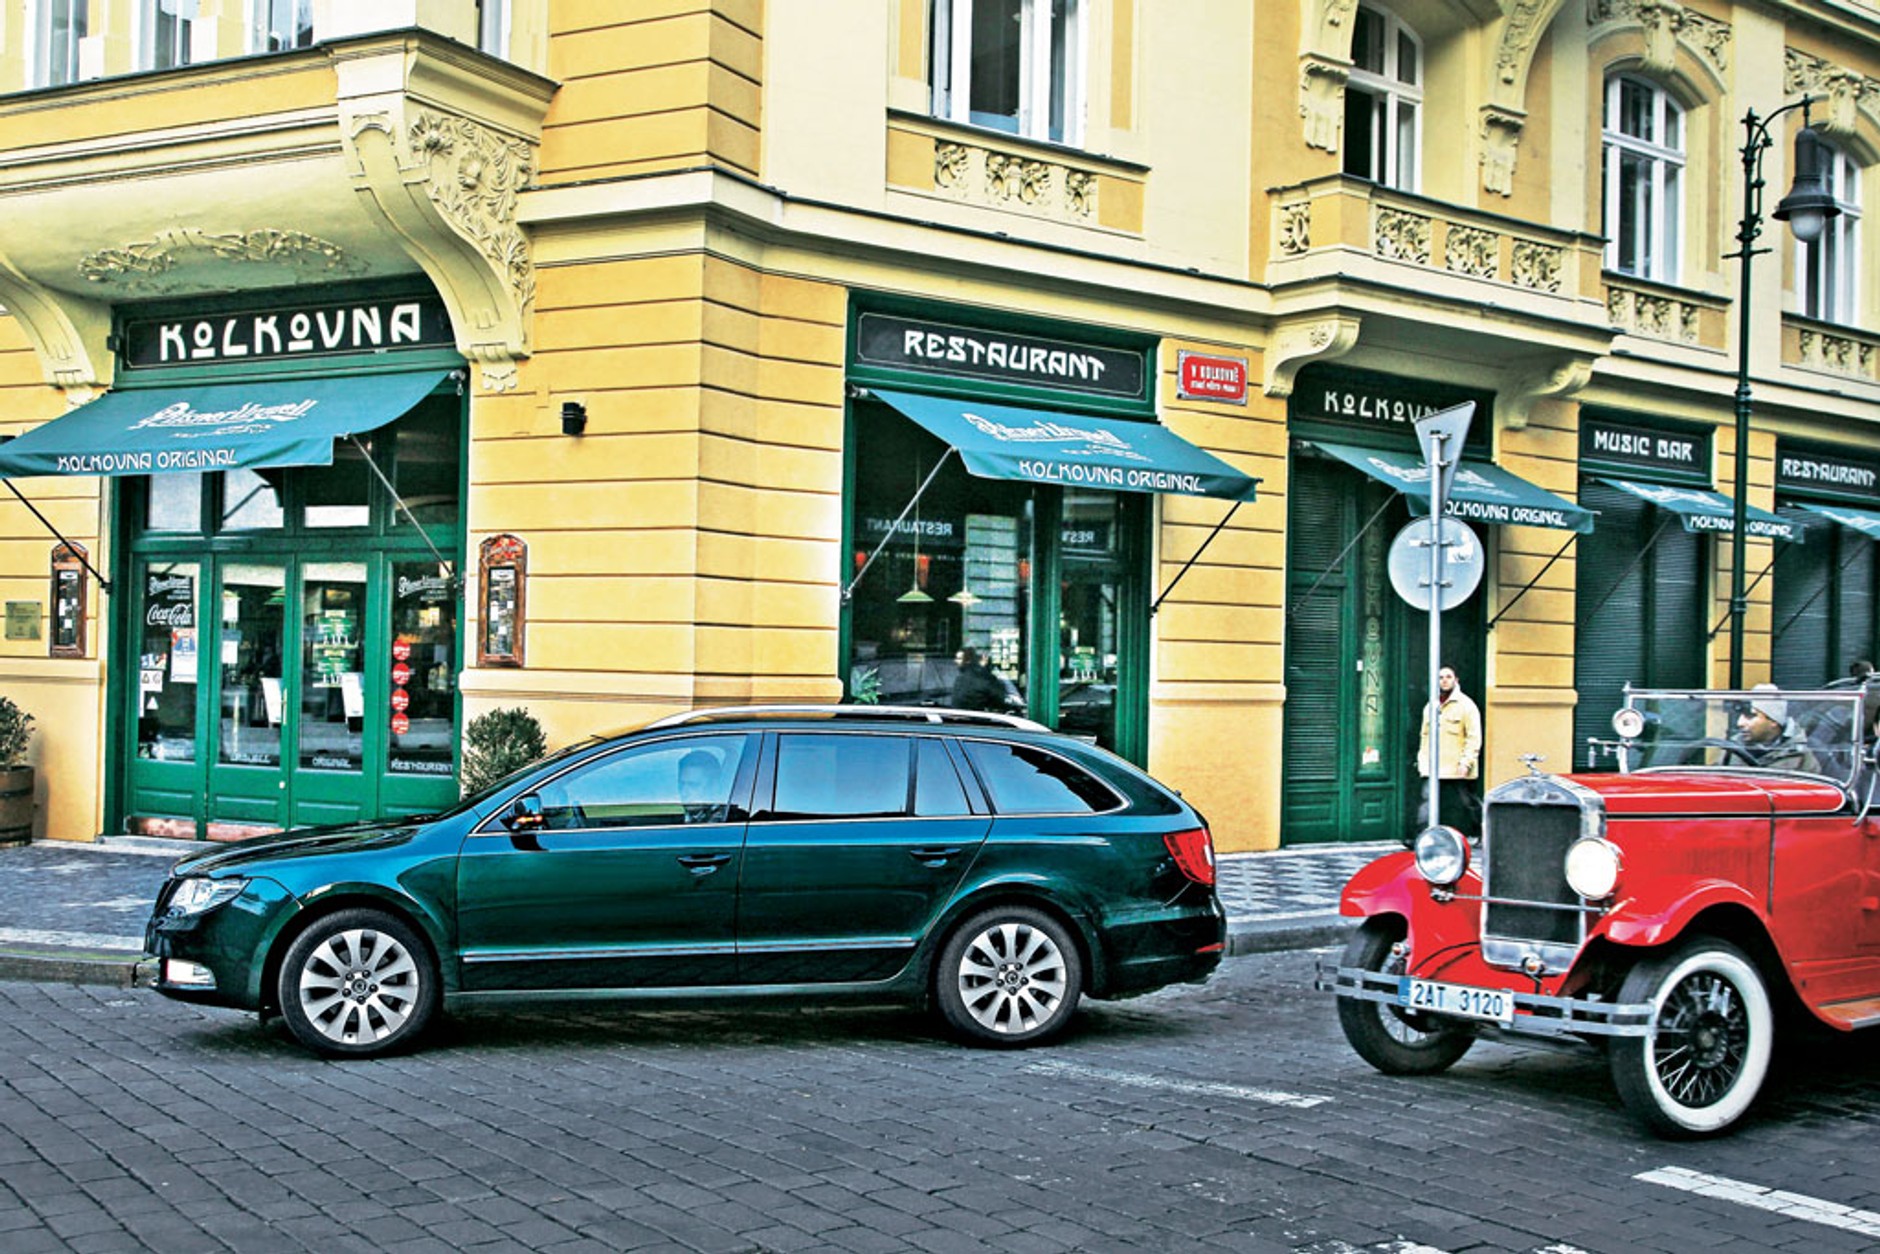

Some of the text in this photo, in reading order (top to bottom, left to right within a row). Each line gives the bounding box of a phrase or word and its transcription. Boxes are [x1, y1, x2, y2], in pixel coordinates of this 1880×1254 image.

[159, 303, 421, 361] KOLKOVNA
[903, 330, 1105, 382] RESTAURANT
[1324, 390, 1440, 424] KOLKOV
[57, 449, 238, 470] KOLKOVNA ORIGINAL
[1594, 430, 1692, 461] MUSIC BAR
[1019, 460, 1206, 493] KOLKOVNA ORIGINAL
[1782, 457, 1876, 487] RESTAURANT
[1443, 499, 1568, 527] OLKOVNA ORIGINAL
[1690, 515, 1747, 533] KOLKOV
[1414, 983, 1503, 1017] 2AT 3120
